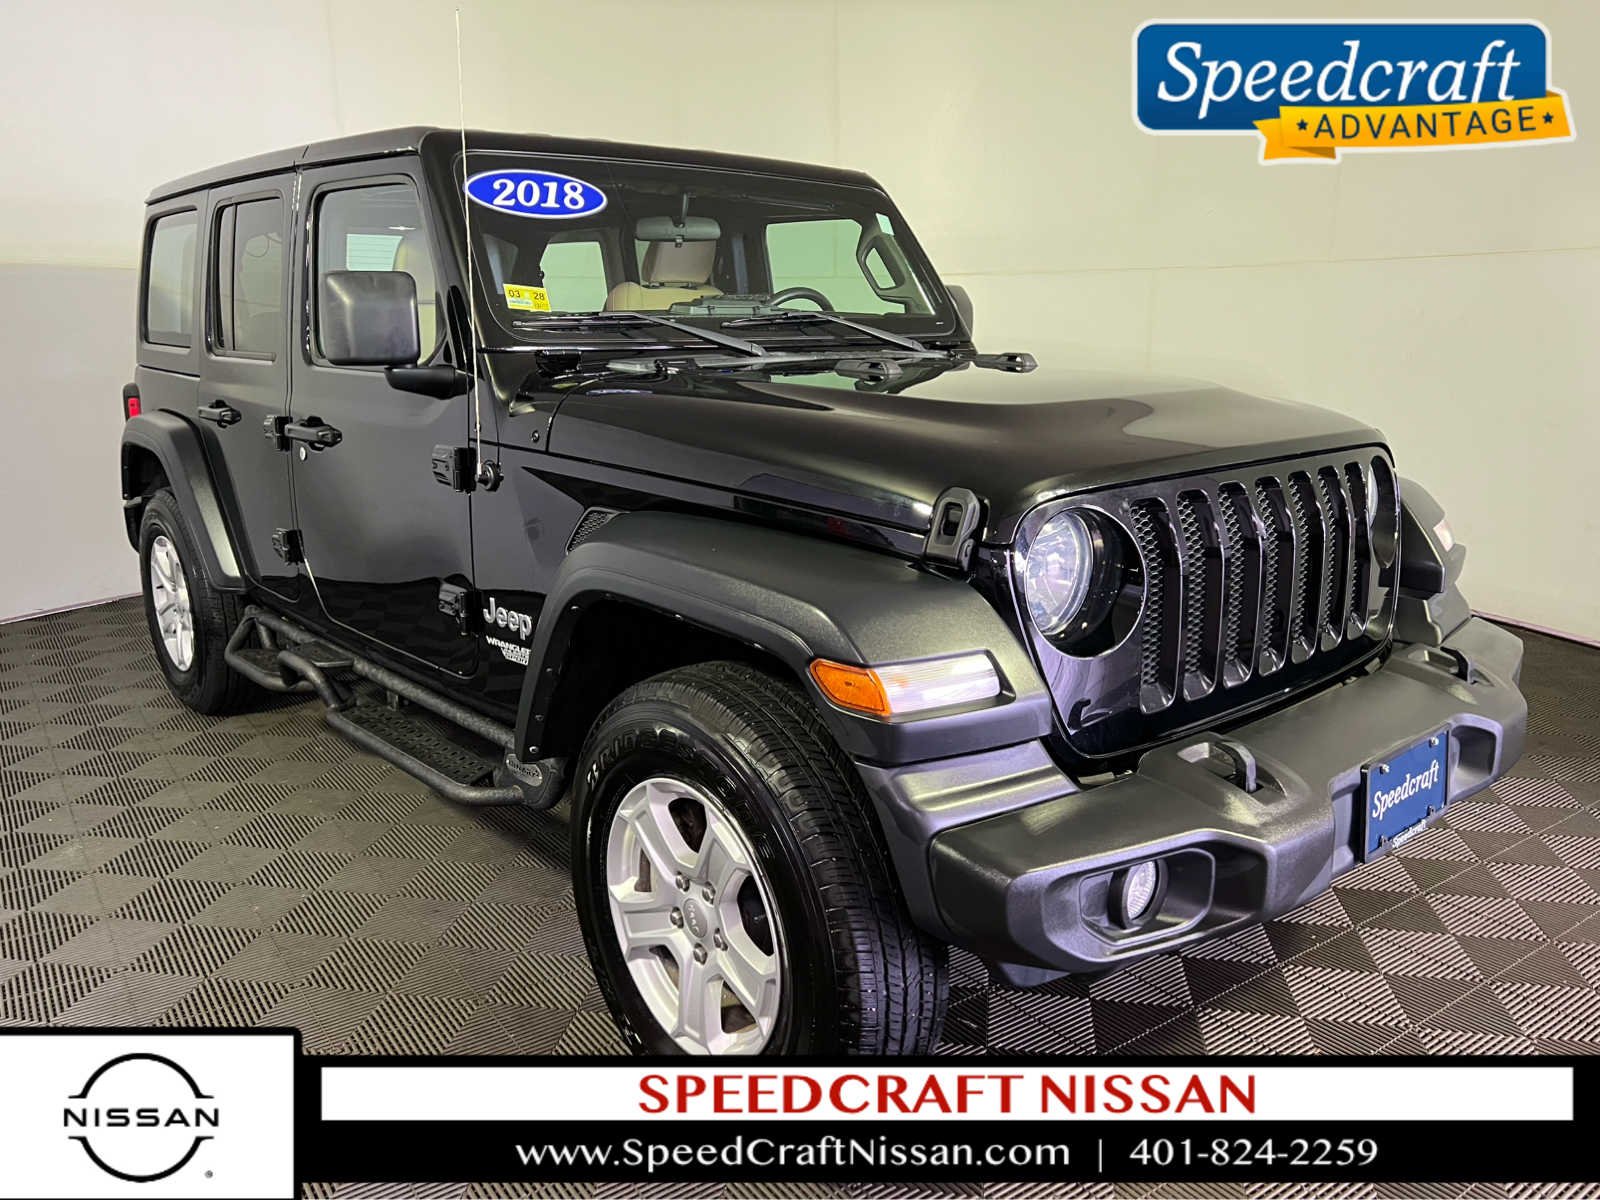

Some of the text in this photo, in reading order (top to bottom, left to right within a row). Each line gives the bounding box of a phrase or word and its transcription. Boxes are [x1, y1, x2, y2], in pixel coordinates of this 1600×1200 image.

[492, 178, 585, 210] 2018
[482, 596, 532, 641] Jeep
[1371, 759, 1440, 821] Speedcraft
